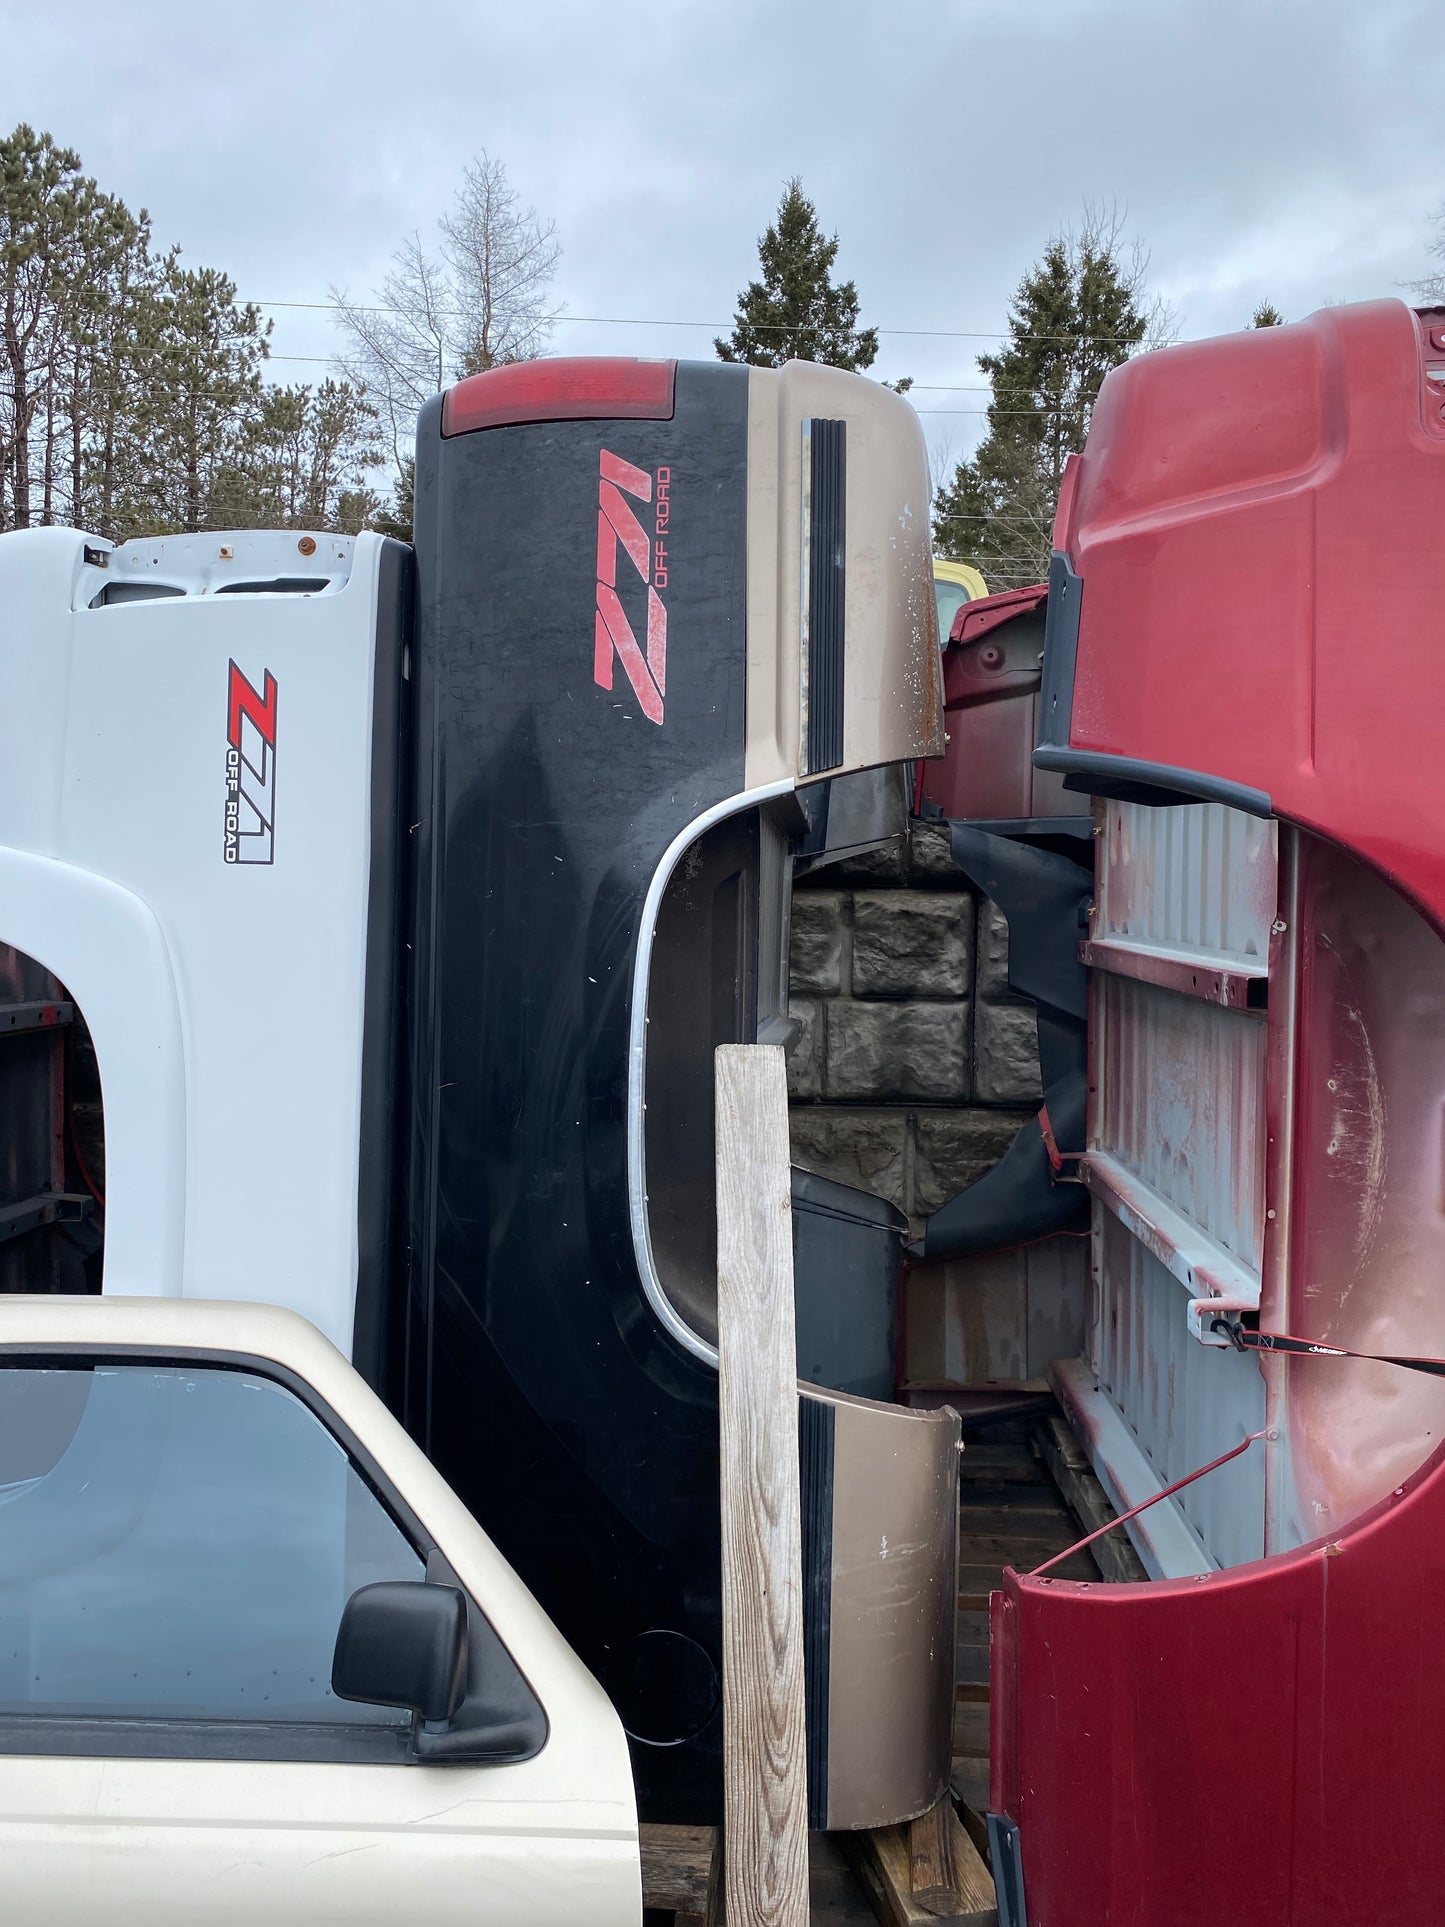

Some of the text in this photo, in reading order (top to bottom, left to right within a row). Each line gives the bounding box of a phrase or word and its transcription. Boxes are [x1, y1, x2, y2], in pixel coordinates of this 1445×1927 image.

[594, 448, 668, 726] Z71
[655, 466, 671, 589] OFF ROAD
[225, 750, 239, 863] OFF ROAD
[227, 657, 278, 865] Z71
